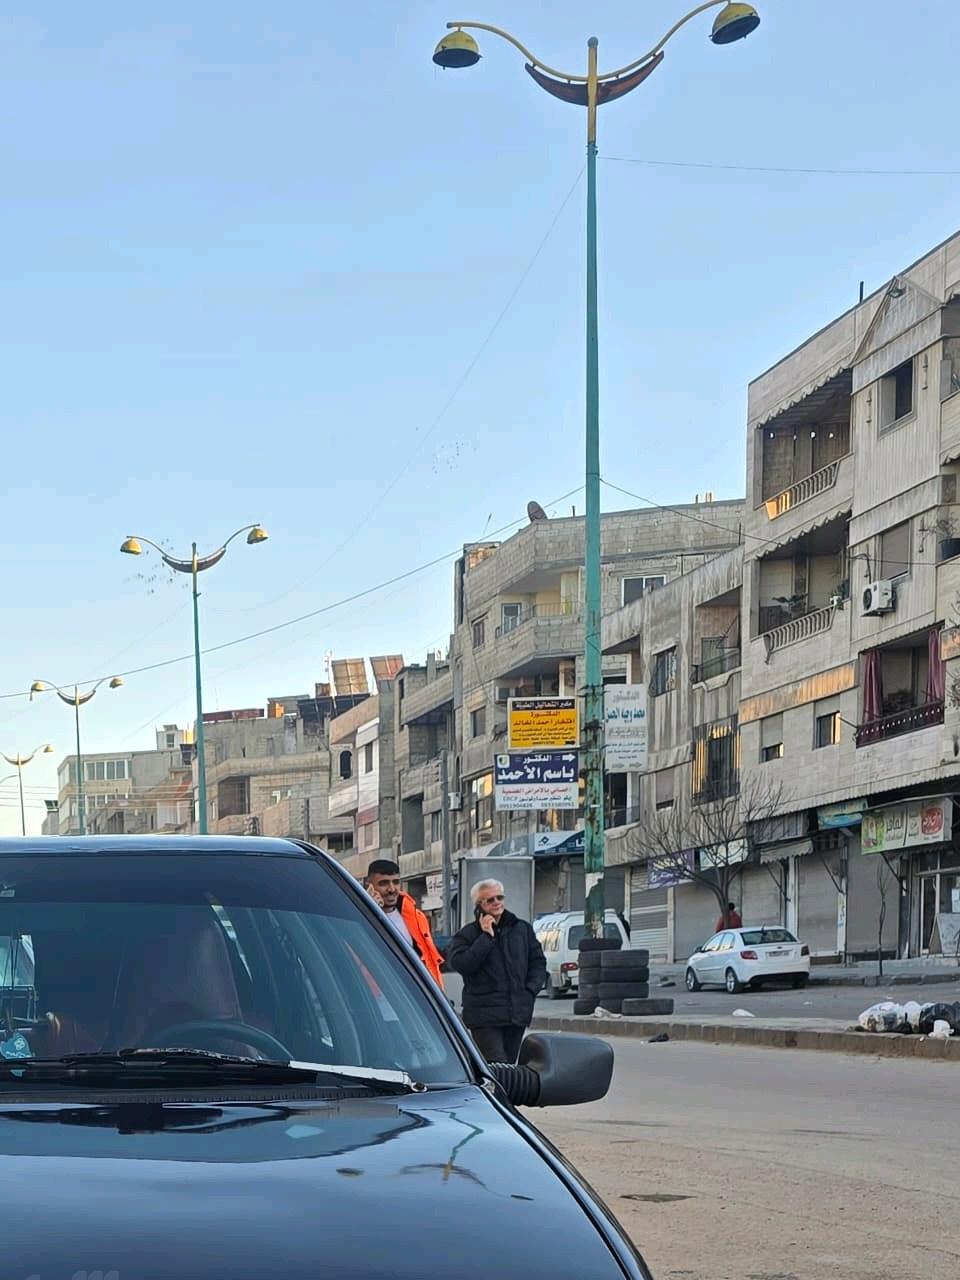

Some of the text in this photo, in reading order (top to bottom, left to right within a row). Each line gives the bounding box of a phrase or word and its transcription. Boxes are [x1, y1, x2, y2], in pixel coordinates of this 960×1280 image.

[523, 754, 552, 764] الدكتور
[497, 765, 575, 782] باسم الأحمد
